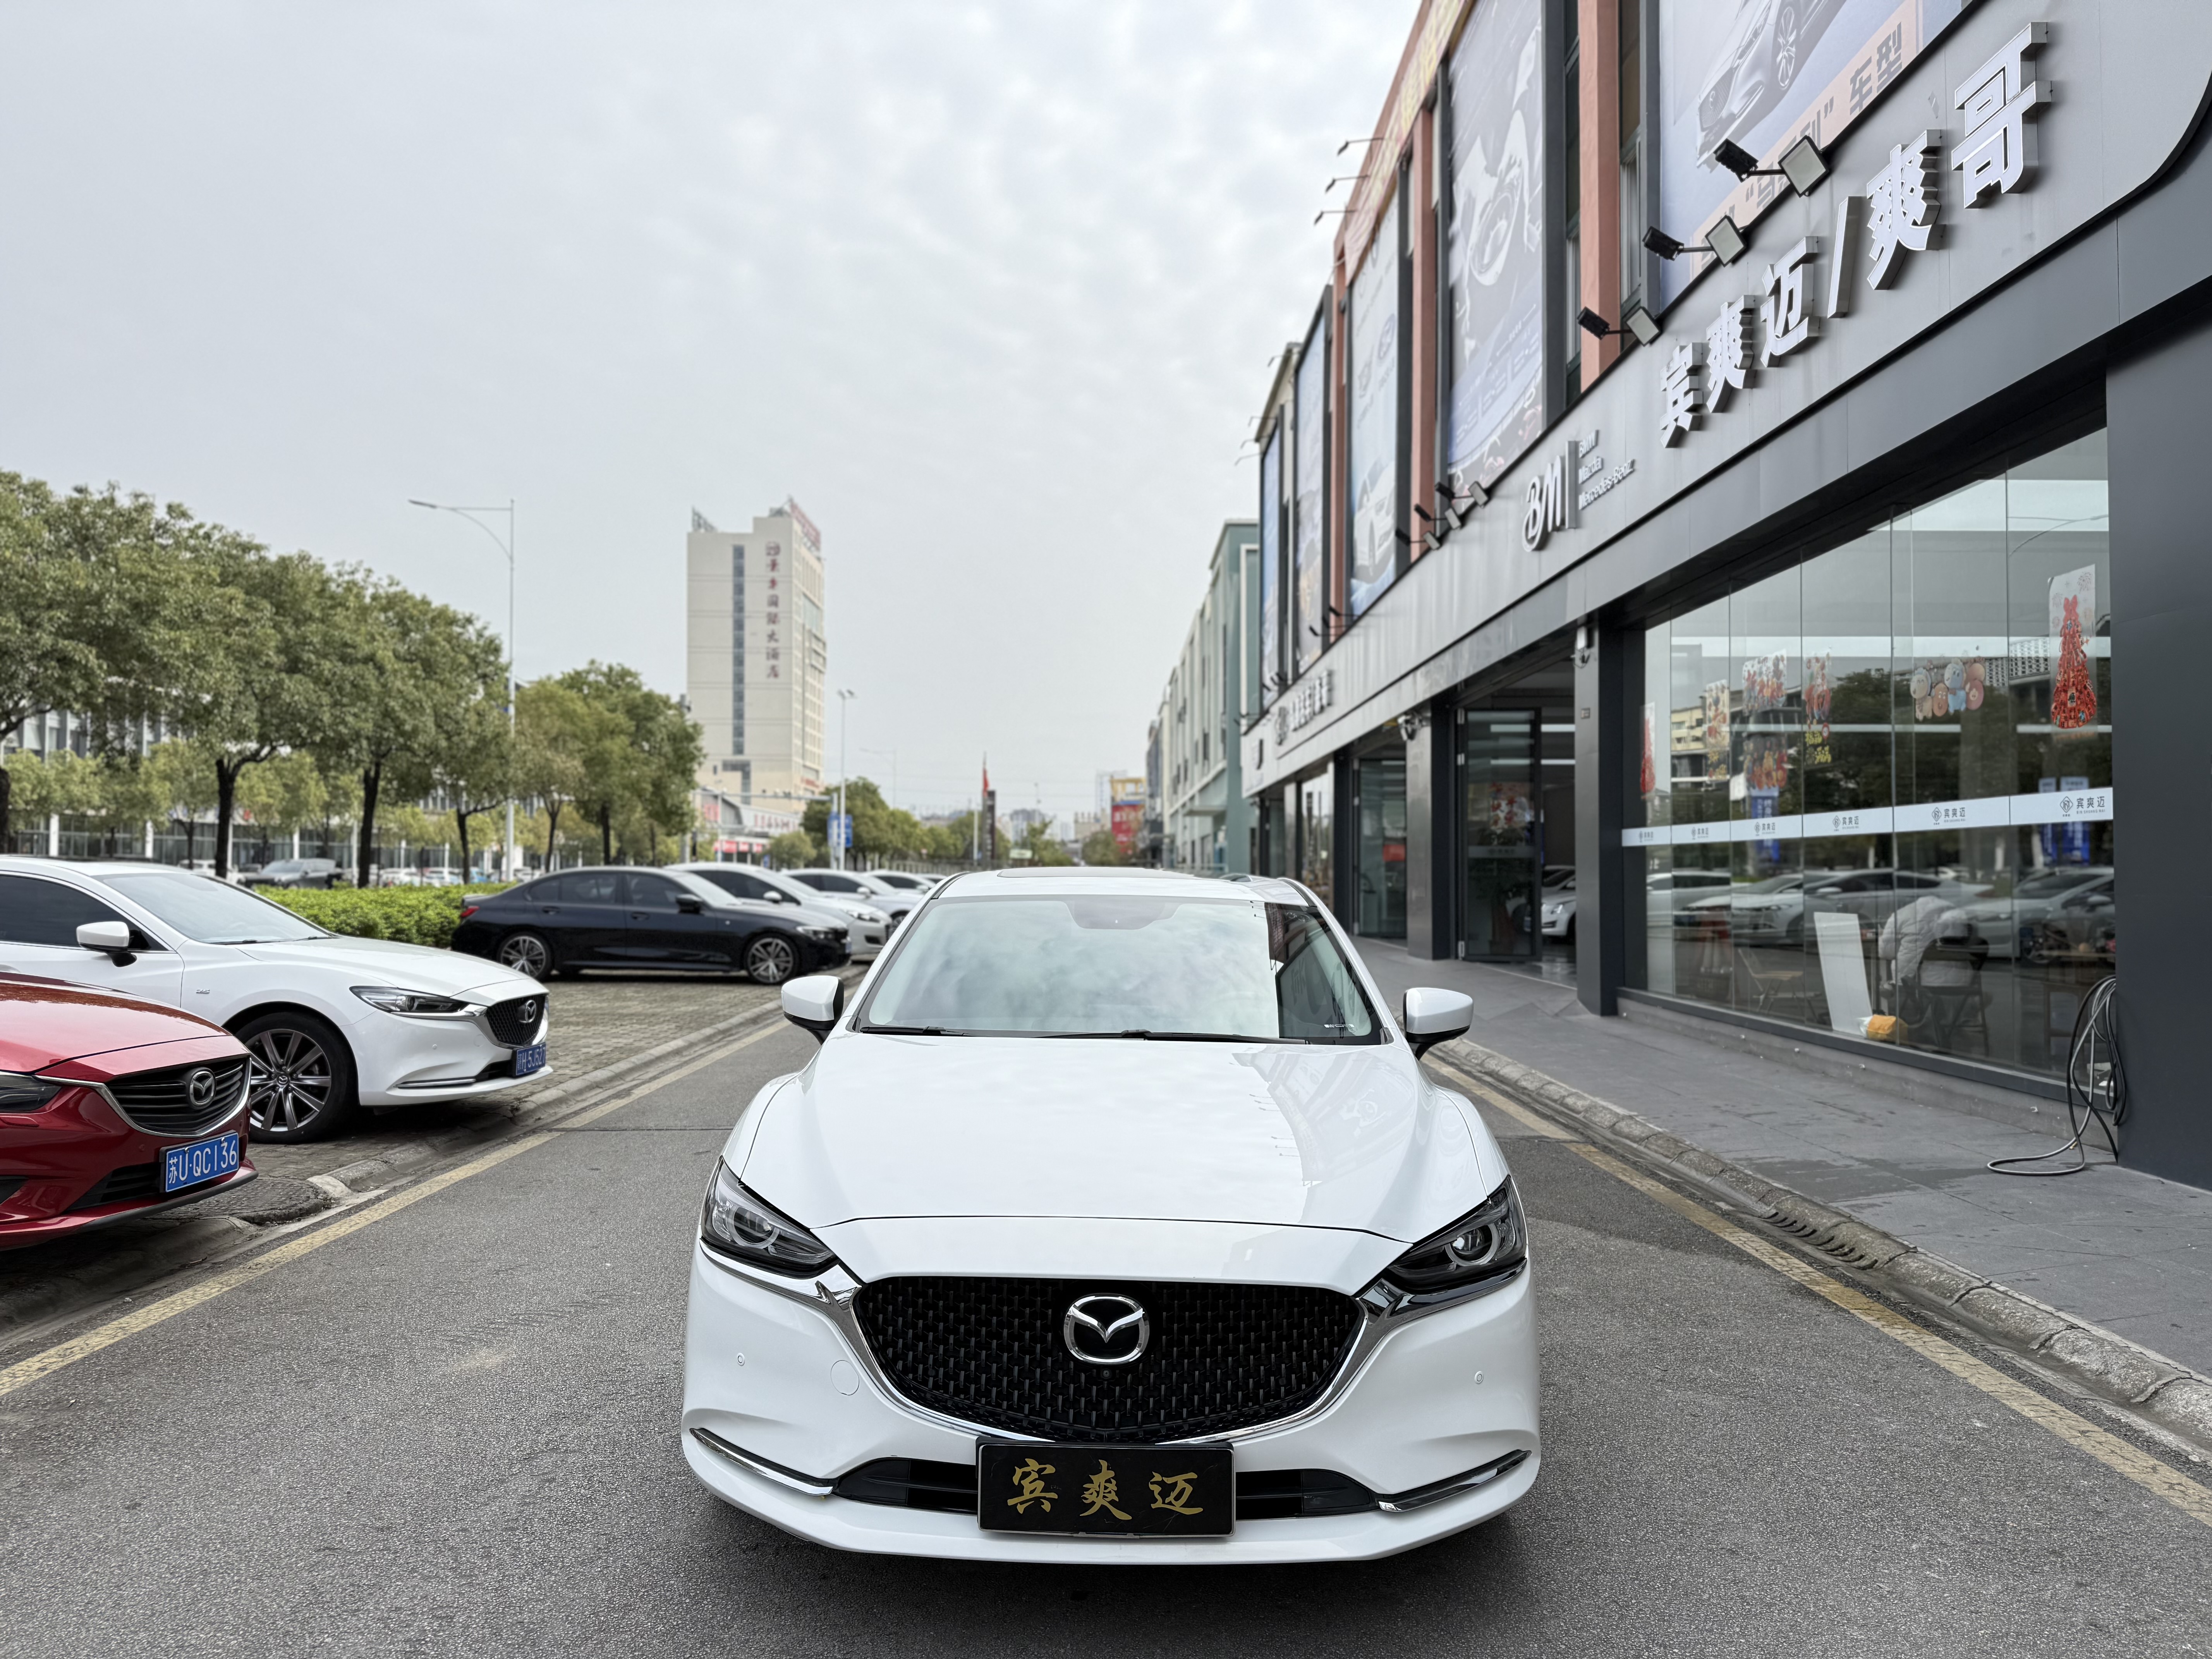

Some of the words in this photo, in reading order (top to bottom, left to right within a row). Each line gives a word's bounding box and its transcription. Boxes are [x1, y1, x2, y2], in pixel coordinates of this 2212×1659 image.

[1660, 22, 2052, 448] 宾爽迈/爽哥
[1579, 429, 1599, 459] BMW
[1579, 456, 1603, 484] Mazda
[1579, 459, 1635, 510] Mercedes-Benz
[1944, 807, 1965, 818] 宾爽迈
[2076, 796, 2105, 809] 宾爽迈
[1007, 1458, 1204, 1520] 宾爽迈
